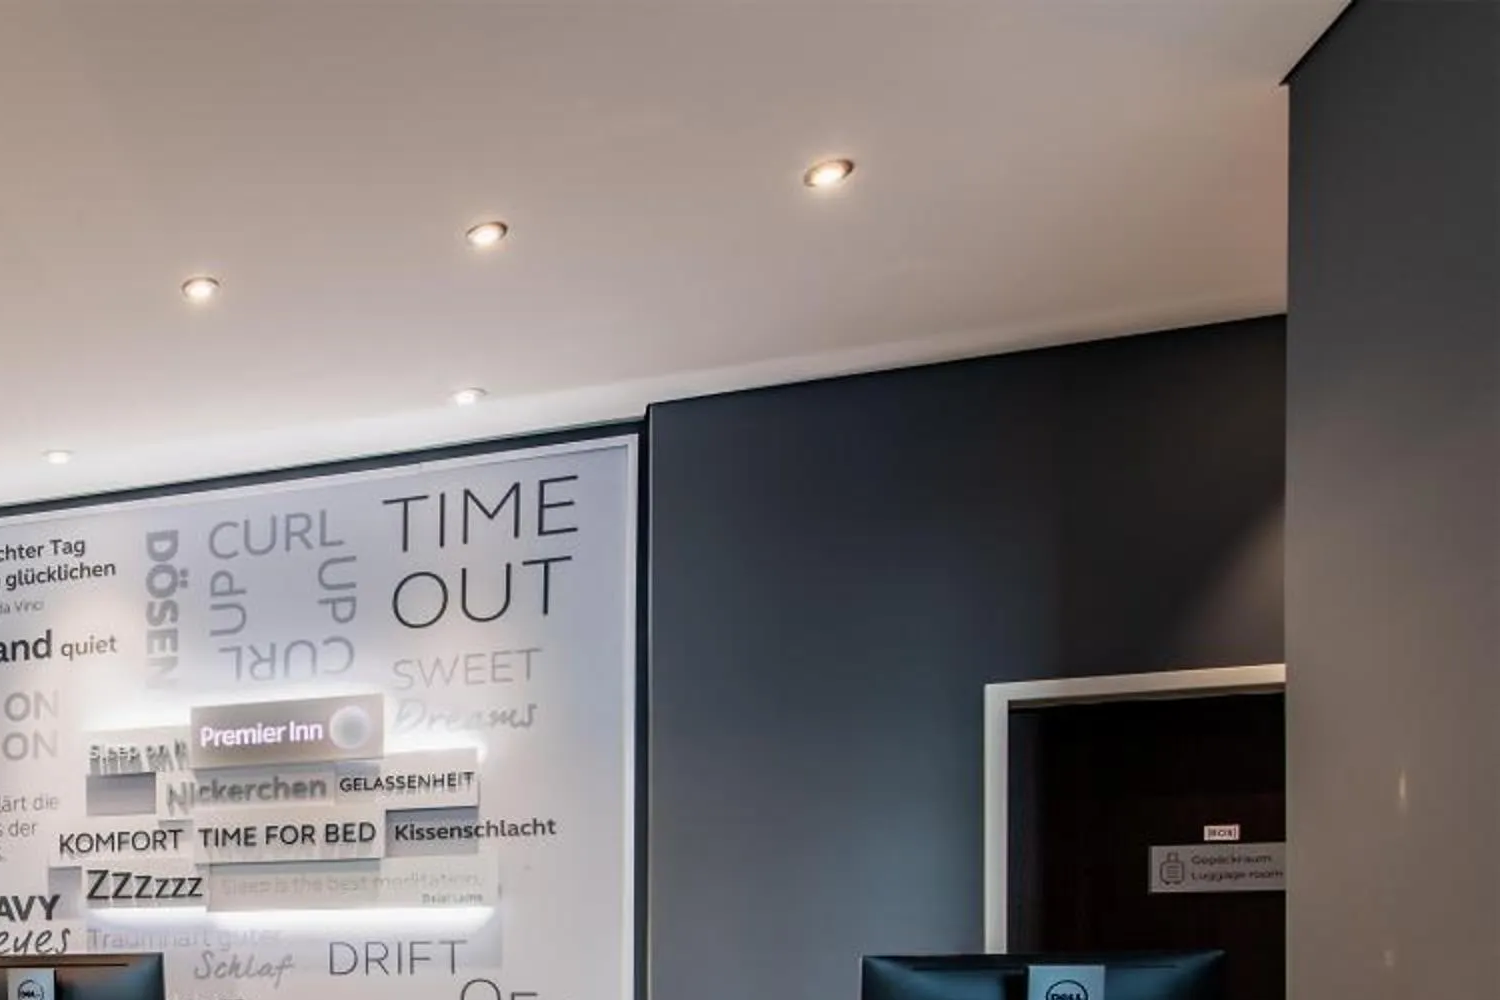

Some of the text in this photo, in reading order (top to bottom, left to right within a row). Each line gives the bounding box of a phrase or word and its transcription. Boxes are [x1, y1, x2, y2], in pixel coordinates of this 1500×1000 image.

[383, 474, 579, 553] TIME
[50, 537, 86, 557] Tag
[208, 508, 345, 560] CURL
[5, 562, 117, 590] glücklichen
[317, 555, 358, 624] UP
[392, 554, 573, 629] OUT
[14, 598, 45, 614] Vinci
[145, 529, 189, 689] DÖSEN
[209, 569, 248, 637] UP
[60, 634, 118, 661] quiet
[217, 635, 356, 683] CURL
[392, 647, 544, 691] SWEET
[4, 690, 58, 723] ON
[393, 696, 538, 734] Dreams
[2, 730, 58, 763] ON
[200, 720, 323, 748] Premier Inn
[166, 775, 327, 809] Nickerchen
[339, 771, 475, 794] GELASSENHEIT
[32, 791, 59, 811] die
[8, 820, 38, 837] der
[58, 828, 185, 855] KOMFORT
[198, 821, 377, 848] TIME FOR BED
[394, 817, 557, 842] Kissenschlacht
[193, 949, 296, 990] Schlaf
[329, 939, 468, 976] DRIFT
